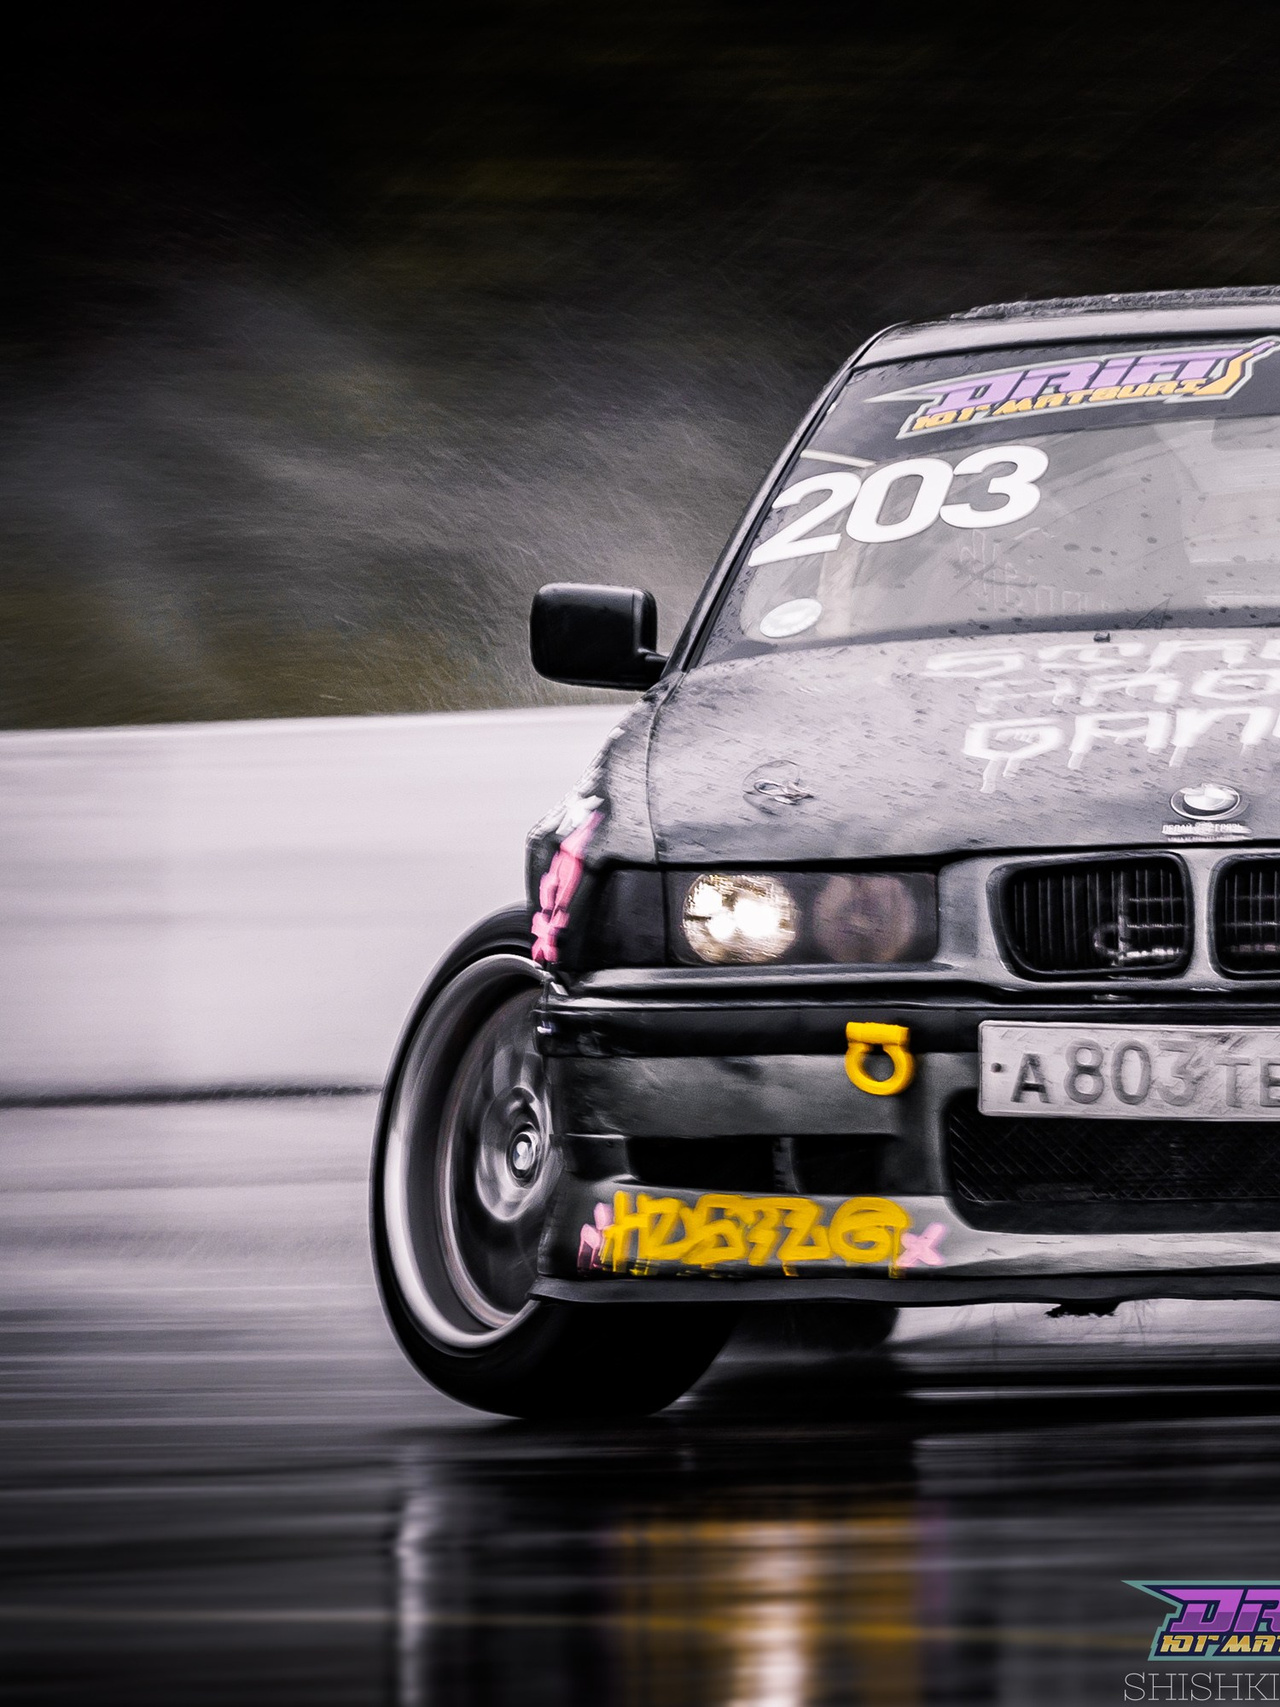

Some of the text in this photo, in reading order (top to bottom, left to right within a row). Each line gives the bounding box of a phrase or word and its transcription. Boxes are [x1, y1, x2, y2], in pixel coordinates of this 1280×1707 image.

[922, 349, 1246, 415] DRIFT
[992, 379, 1208, 415] MATSURI
[748, 445, 1049, 567] 203
